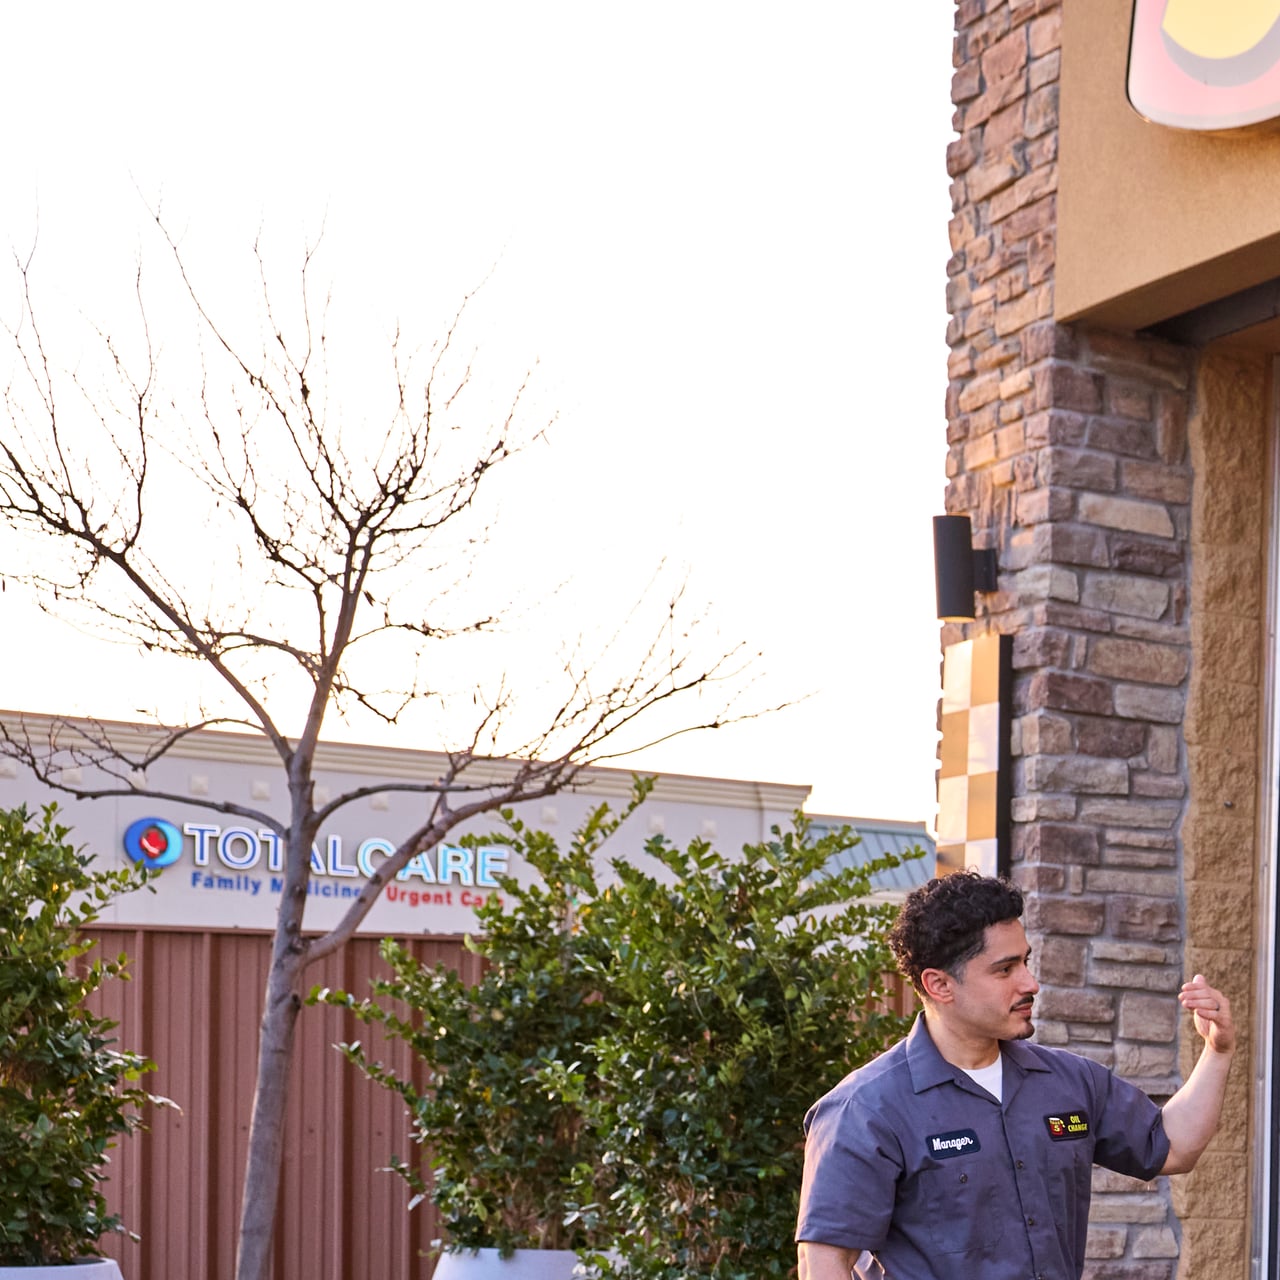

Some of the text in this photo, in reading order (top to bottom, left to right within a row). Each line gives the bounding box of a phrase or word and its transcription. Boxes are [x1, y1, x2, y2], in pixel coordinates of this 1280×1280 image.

[191, 871, 504, 908] Family Micin Urgent Ca
[932, 1136, 974, 1151] Manager
